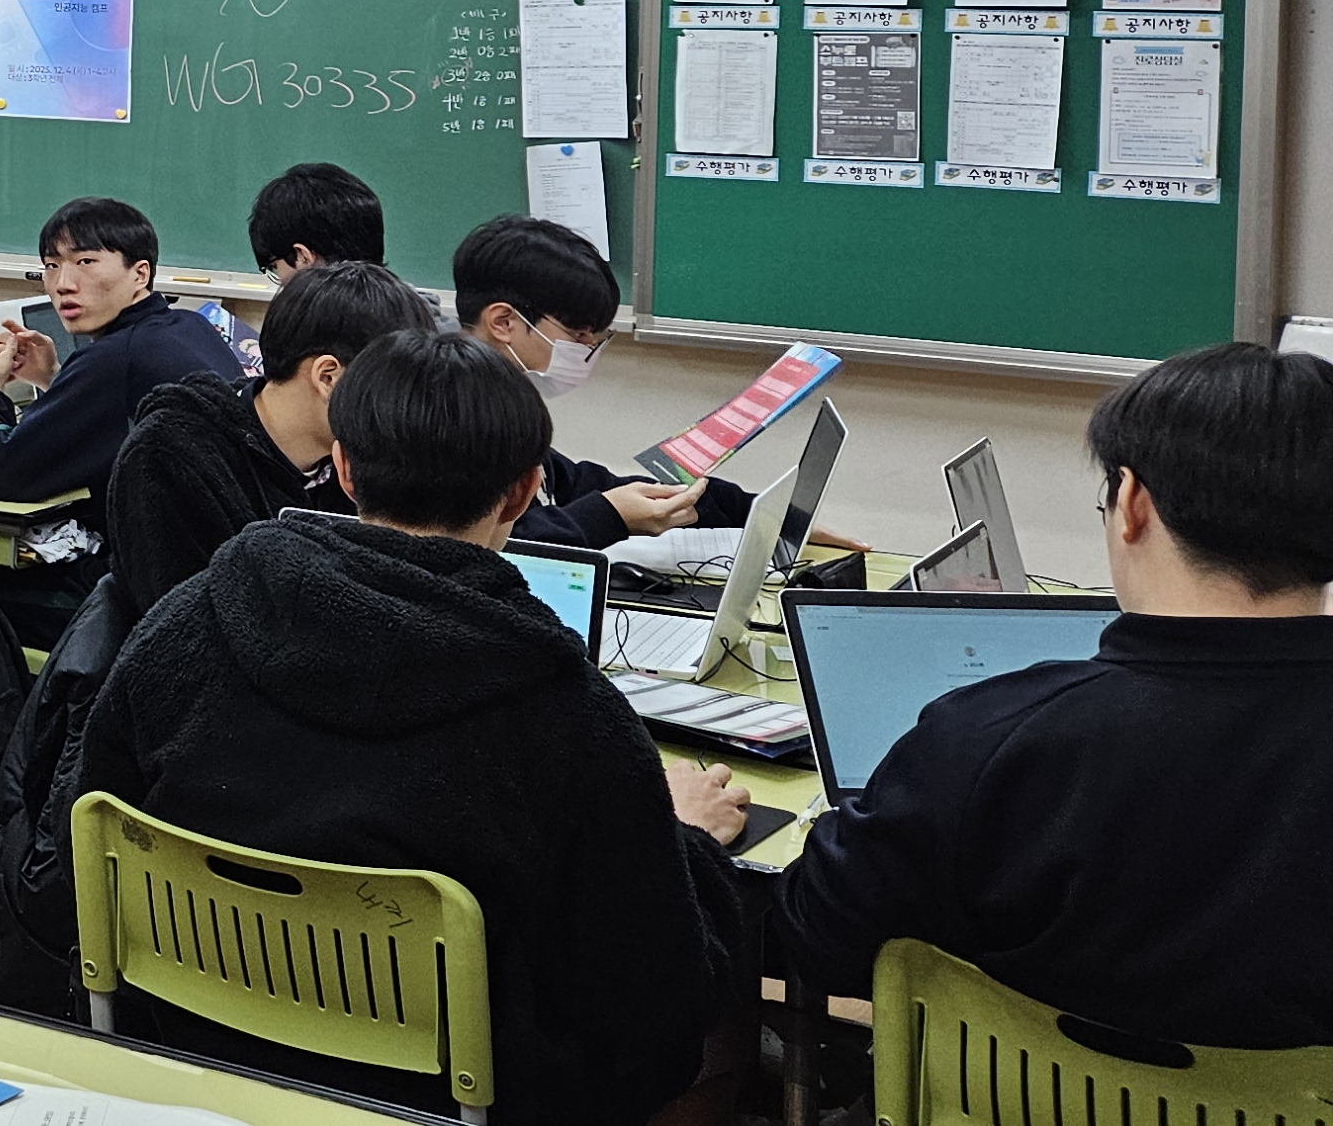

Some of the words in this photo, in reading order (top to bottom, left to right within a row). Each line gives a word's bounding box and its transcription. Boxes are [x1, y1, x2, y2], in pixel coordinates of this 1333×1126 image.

[54, 2, 88, 13] 인공지능
[92, 3, 108, 13] 캠프
[697, 10, 753, 25] 공지사항
[833, 12, 893, 27] 공지사항
[976, 14, 1039, 30] 공지사항
[1125, 18, 1191, 34] 공지사항
[449, 46, 468, 60] 2반
[445, 68, 466, 82] 3반
[695, 160, 751, 176] 수행평가
[834, 164, 894, 181] 수행평가
[967, 168, 1029, 186] 수행평가
[1122, 178, 1188, 196] 수행평가
